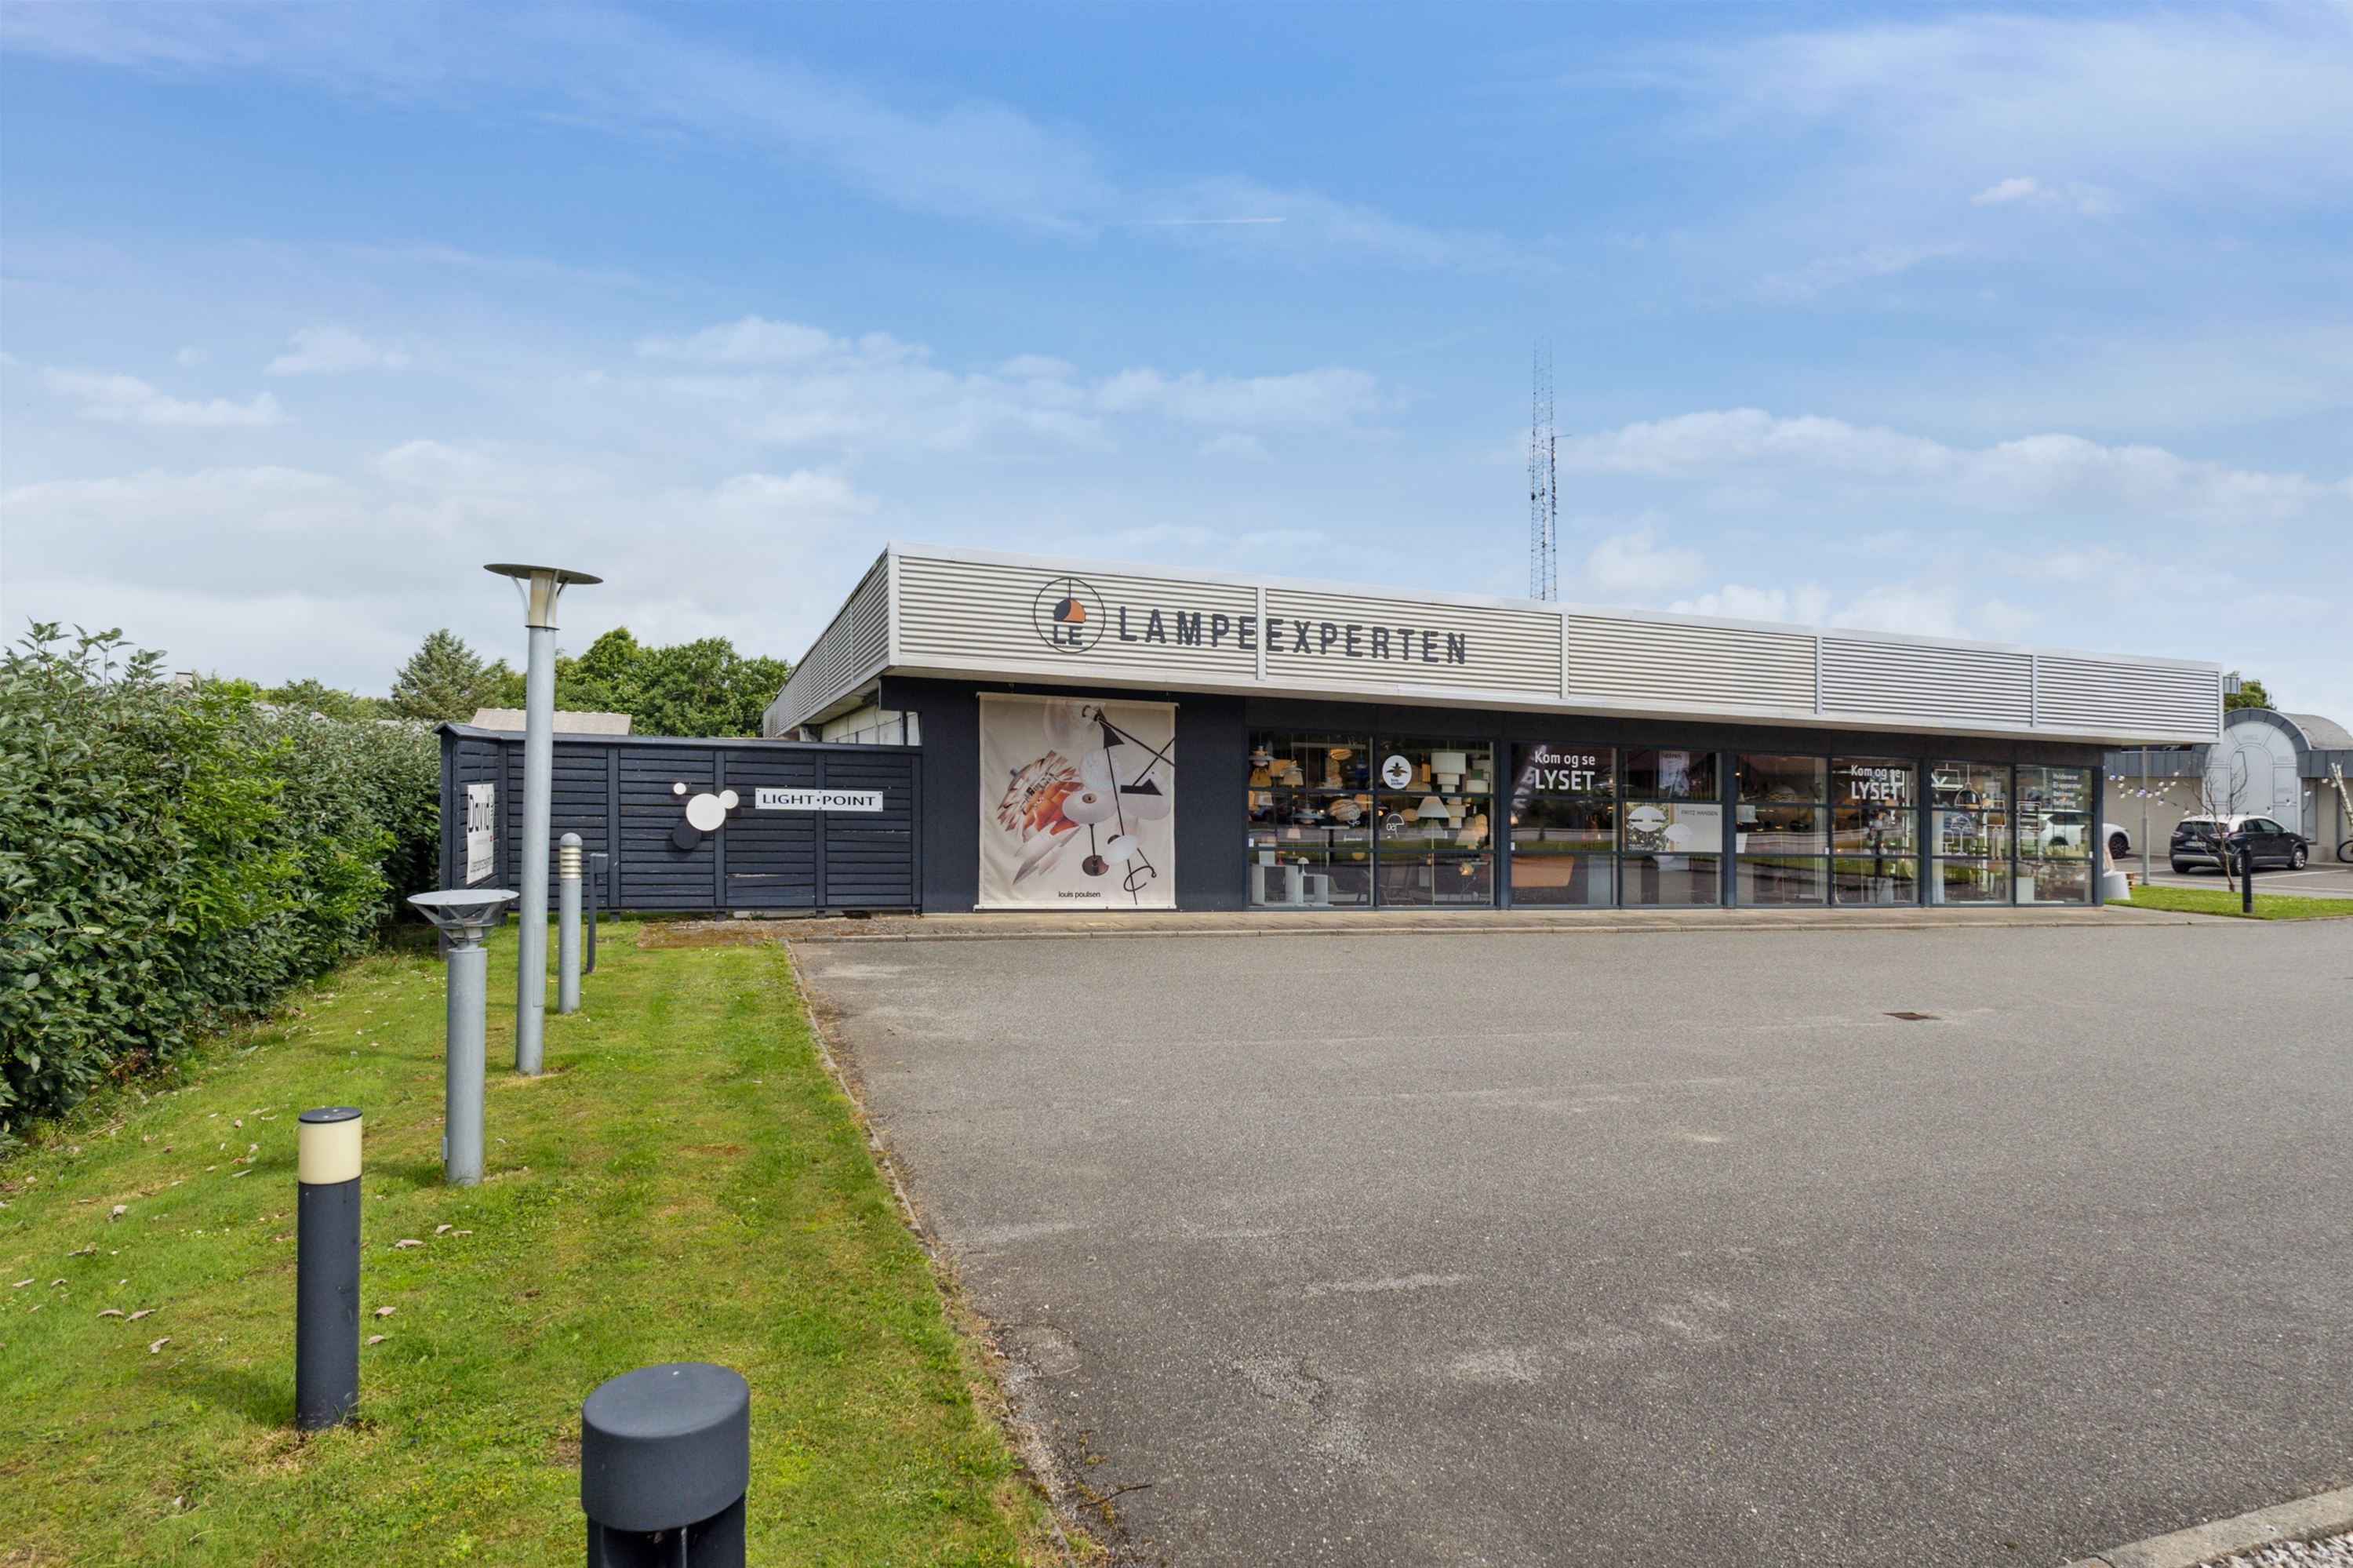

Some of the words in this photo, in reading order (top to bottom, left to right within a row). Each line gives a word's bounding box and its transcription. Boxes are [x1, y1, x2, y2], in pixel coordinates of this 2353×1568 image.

[1053, 624, 1084, 646] LE
[1119, 606, 1467, 665] LAMPEEXPERTEN
[1534, 751, 1561, 764] Kom
[1564, 755, 1578, 768] og
[1581, 755, 1595, 766] se
[1535, 769, 1595, 791] LYSET
[1851, 765, 1872, 777] Kom
[1875, 768, 1887, 780] og
[1889, 769, 1901, 777] se
[1851, 781, 1900, 801] LYSET
